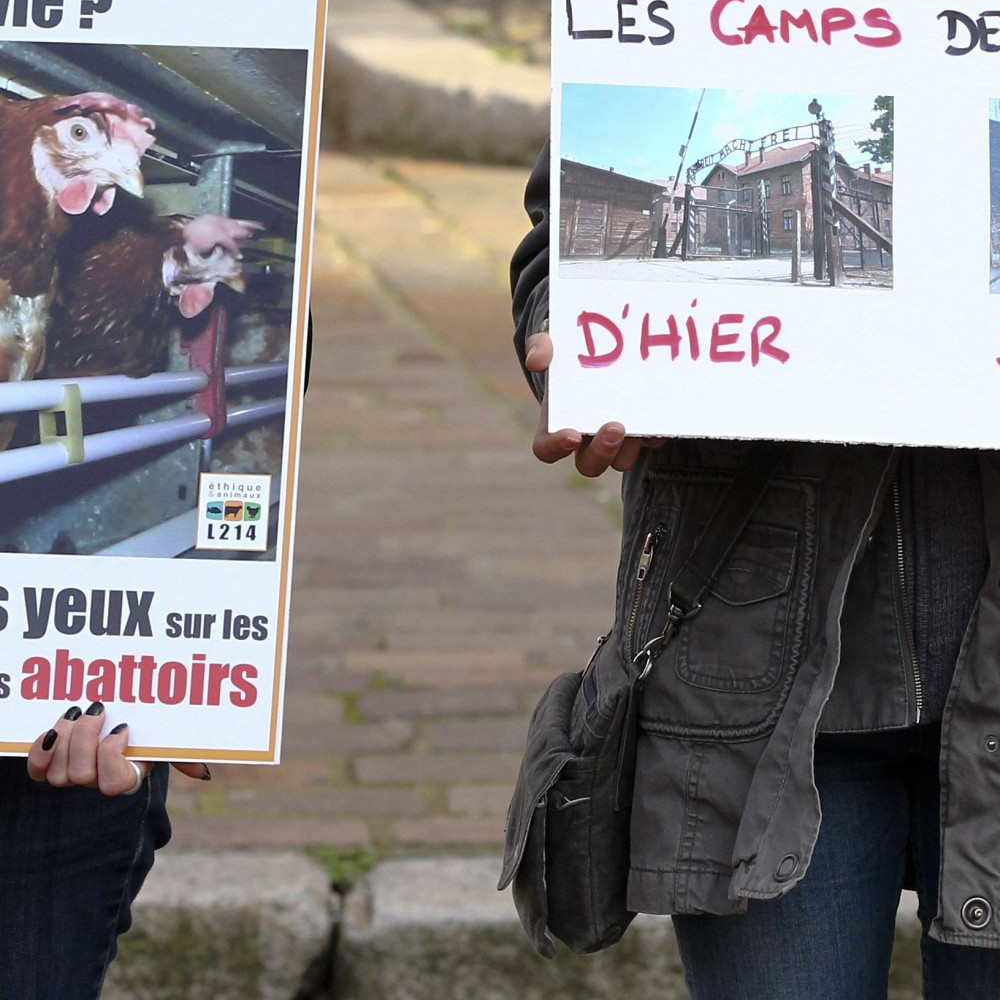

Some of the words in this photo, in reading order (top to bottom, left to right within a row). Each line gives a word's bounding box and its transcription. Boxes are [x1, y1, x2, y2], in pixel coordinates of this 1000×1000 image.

[208, 482, 262, 492] éthique
[216, 491, 261, 499] animaux
[207, 523, 257, 541] L214
[23, 586, 155, 639] yeux
[165, 612, 216, 639] sur
[222, 609, 268, 641] les
[20, 649, 258, 707] abattoirs
